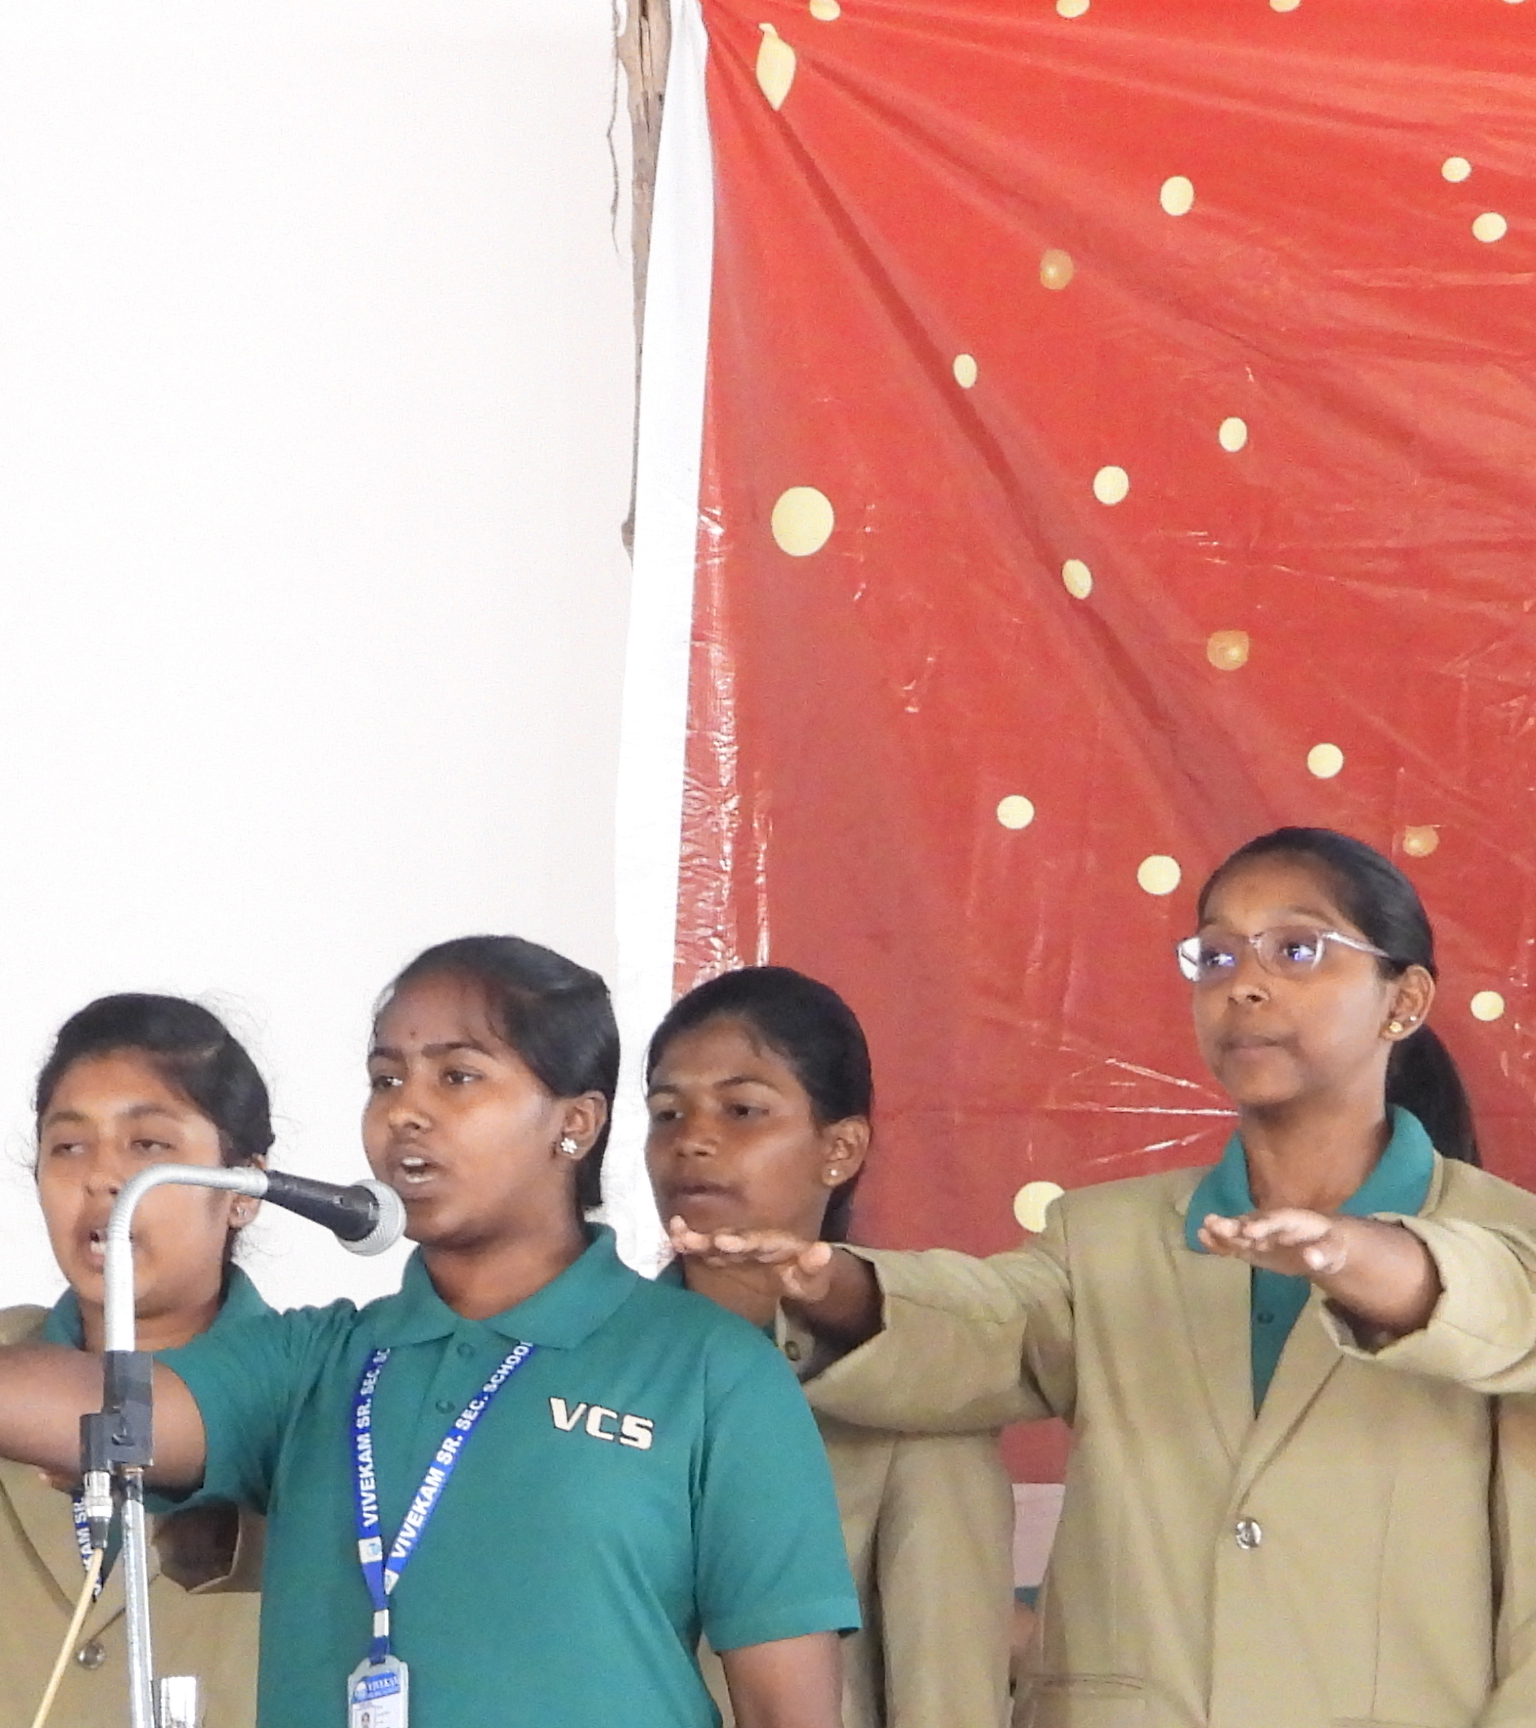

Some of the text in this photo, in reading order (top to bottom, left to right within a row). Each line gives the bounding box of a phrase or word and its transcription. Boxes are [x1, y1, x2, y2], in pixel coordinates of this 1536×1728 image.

[356, 1397, 372, 1429] SR.
[548, 1395, 655, 1451] VCS
[356, 1432, 379, 1528] VIVEKAM
[390, 1465, 445, 1559] VIVEKAM
[436, 1434, 464, 1465] SR.
[455, 1395, 489, 1431] SEC.
